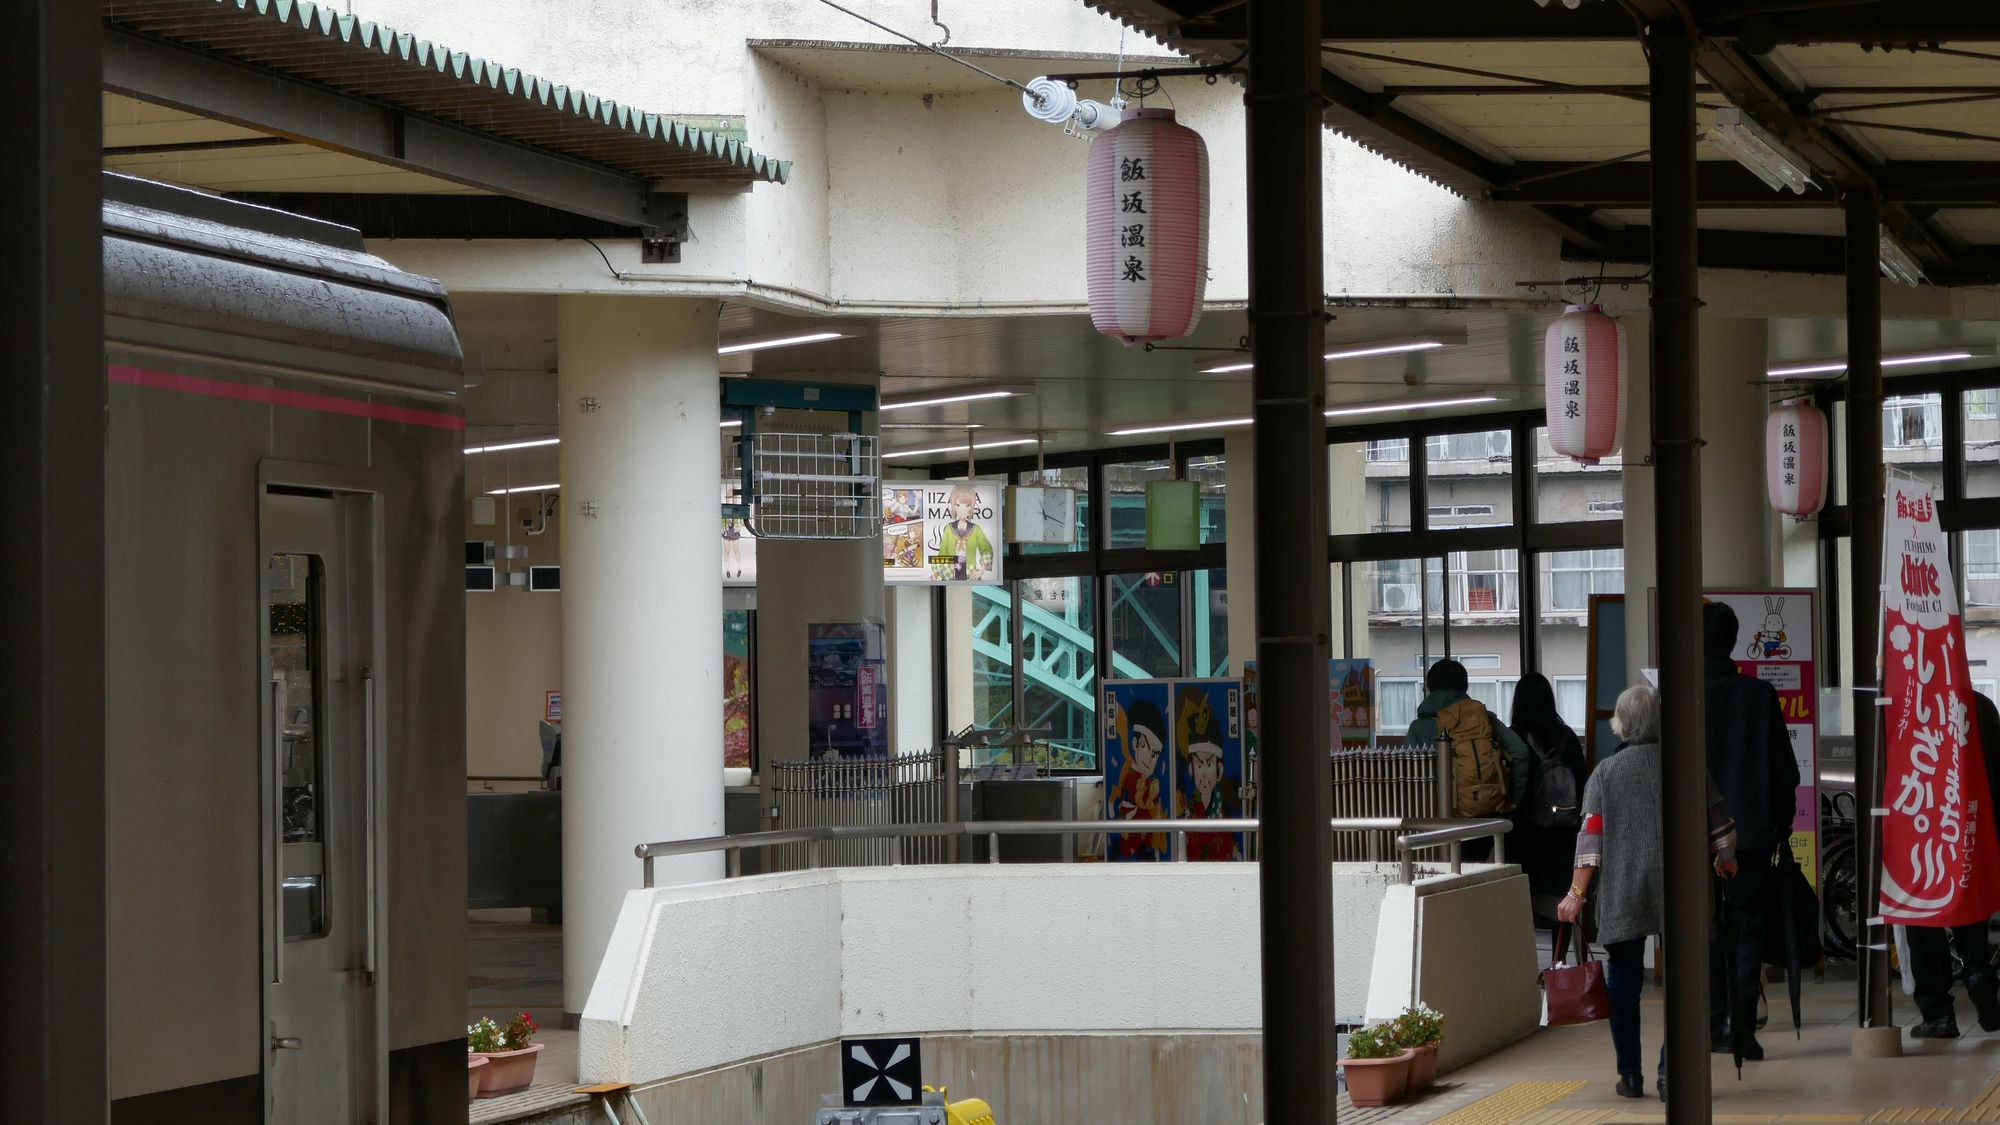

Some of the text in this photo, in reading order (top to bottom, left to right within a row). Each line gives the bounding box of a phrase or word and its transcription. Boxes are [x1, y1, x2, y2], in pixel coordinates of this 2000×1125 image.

[1120, 157, 1147, 283] 飯坂温泉
[1563, 337, 1581, 419] 飯坂温泉
[1783, 424, 1796, 485] 飯坂温泉
[928, 492, 982, 504] IIZA
[928, 508, 993, 519] MARO
[860, 670, 873, 725] 飯坂温泉
[1898, 676, 1914, 740] いいサッカー
